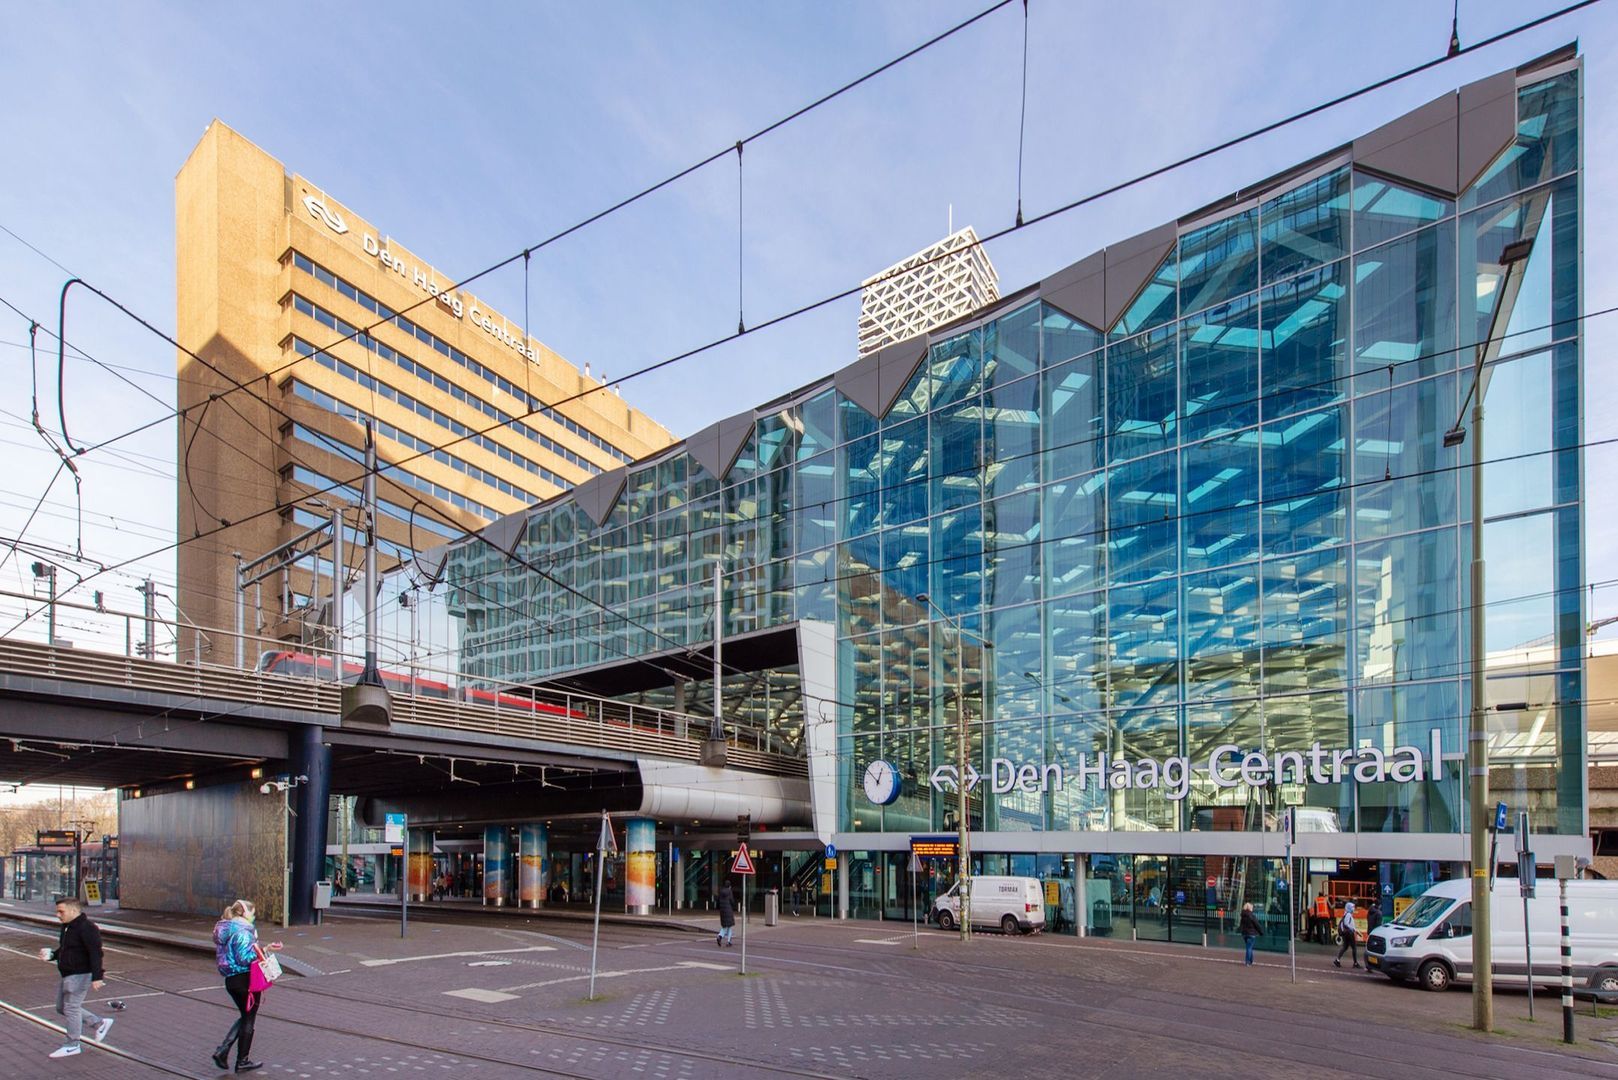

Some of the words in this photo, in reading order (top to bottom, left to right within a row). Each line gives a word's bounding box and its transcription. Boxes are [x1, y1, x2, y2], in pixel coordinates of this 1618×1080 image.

[363, 232, 406, 277] Den
[412, 266, 464, 318] Haag
[468, 306, 541, 366] Centraal
[991, 758, 1064, 794] Den
[1079, 751, 1190, 800] Haag
[1208, 728, 1443, 787] Centraal
